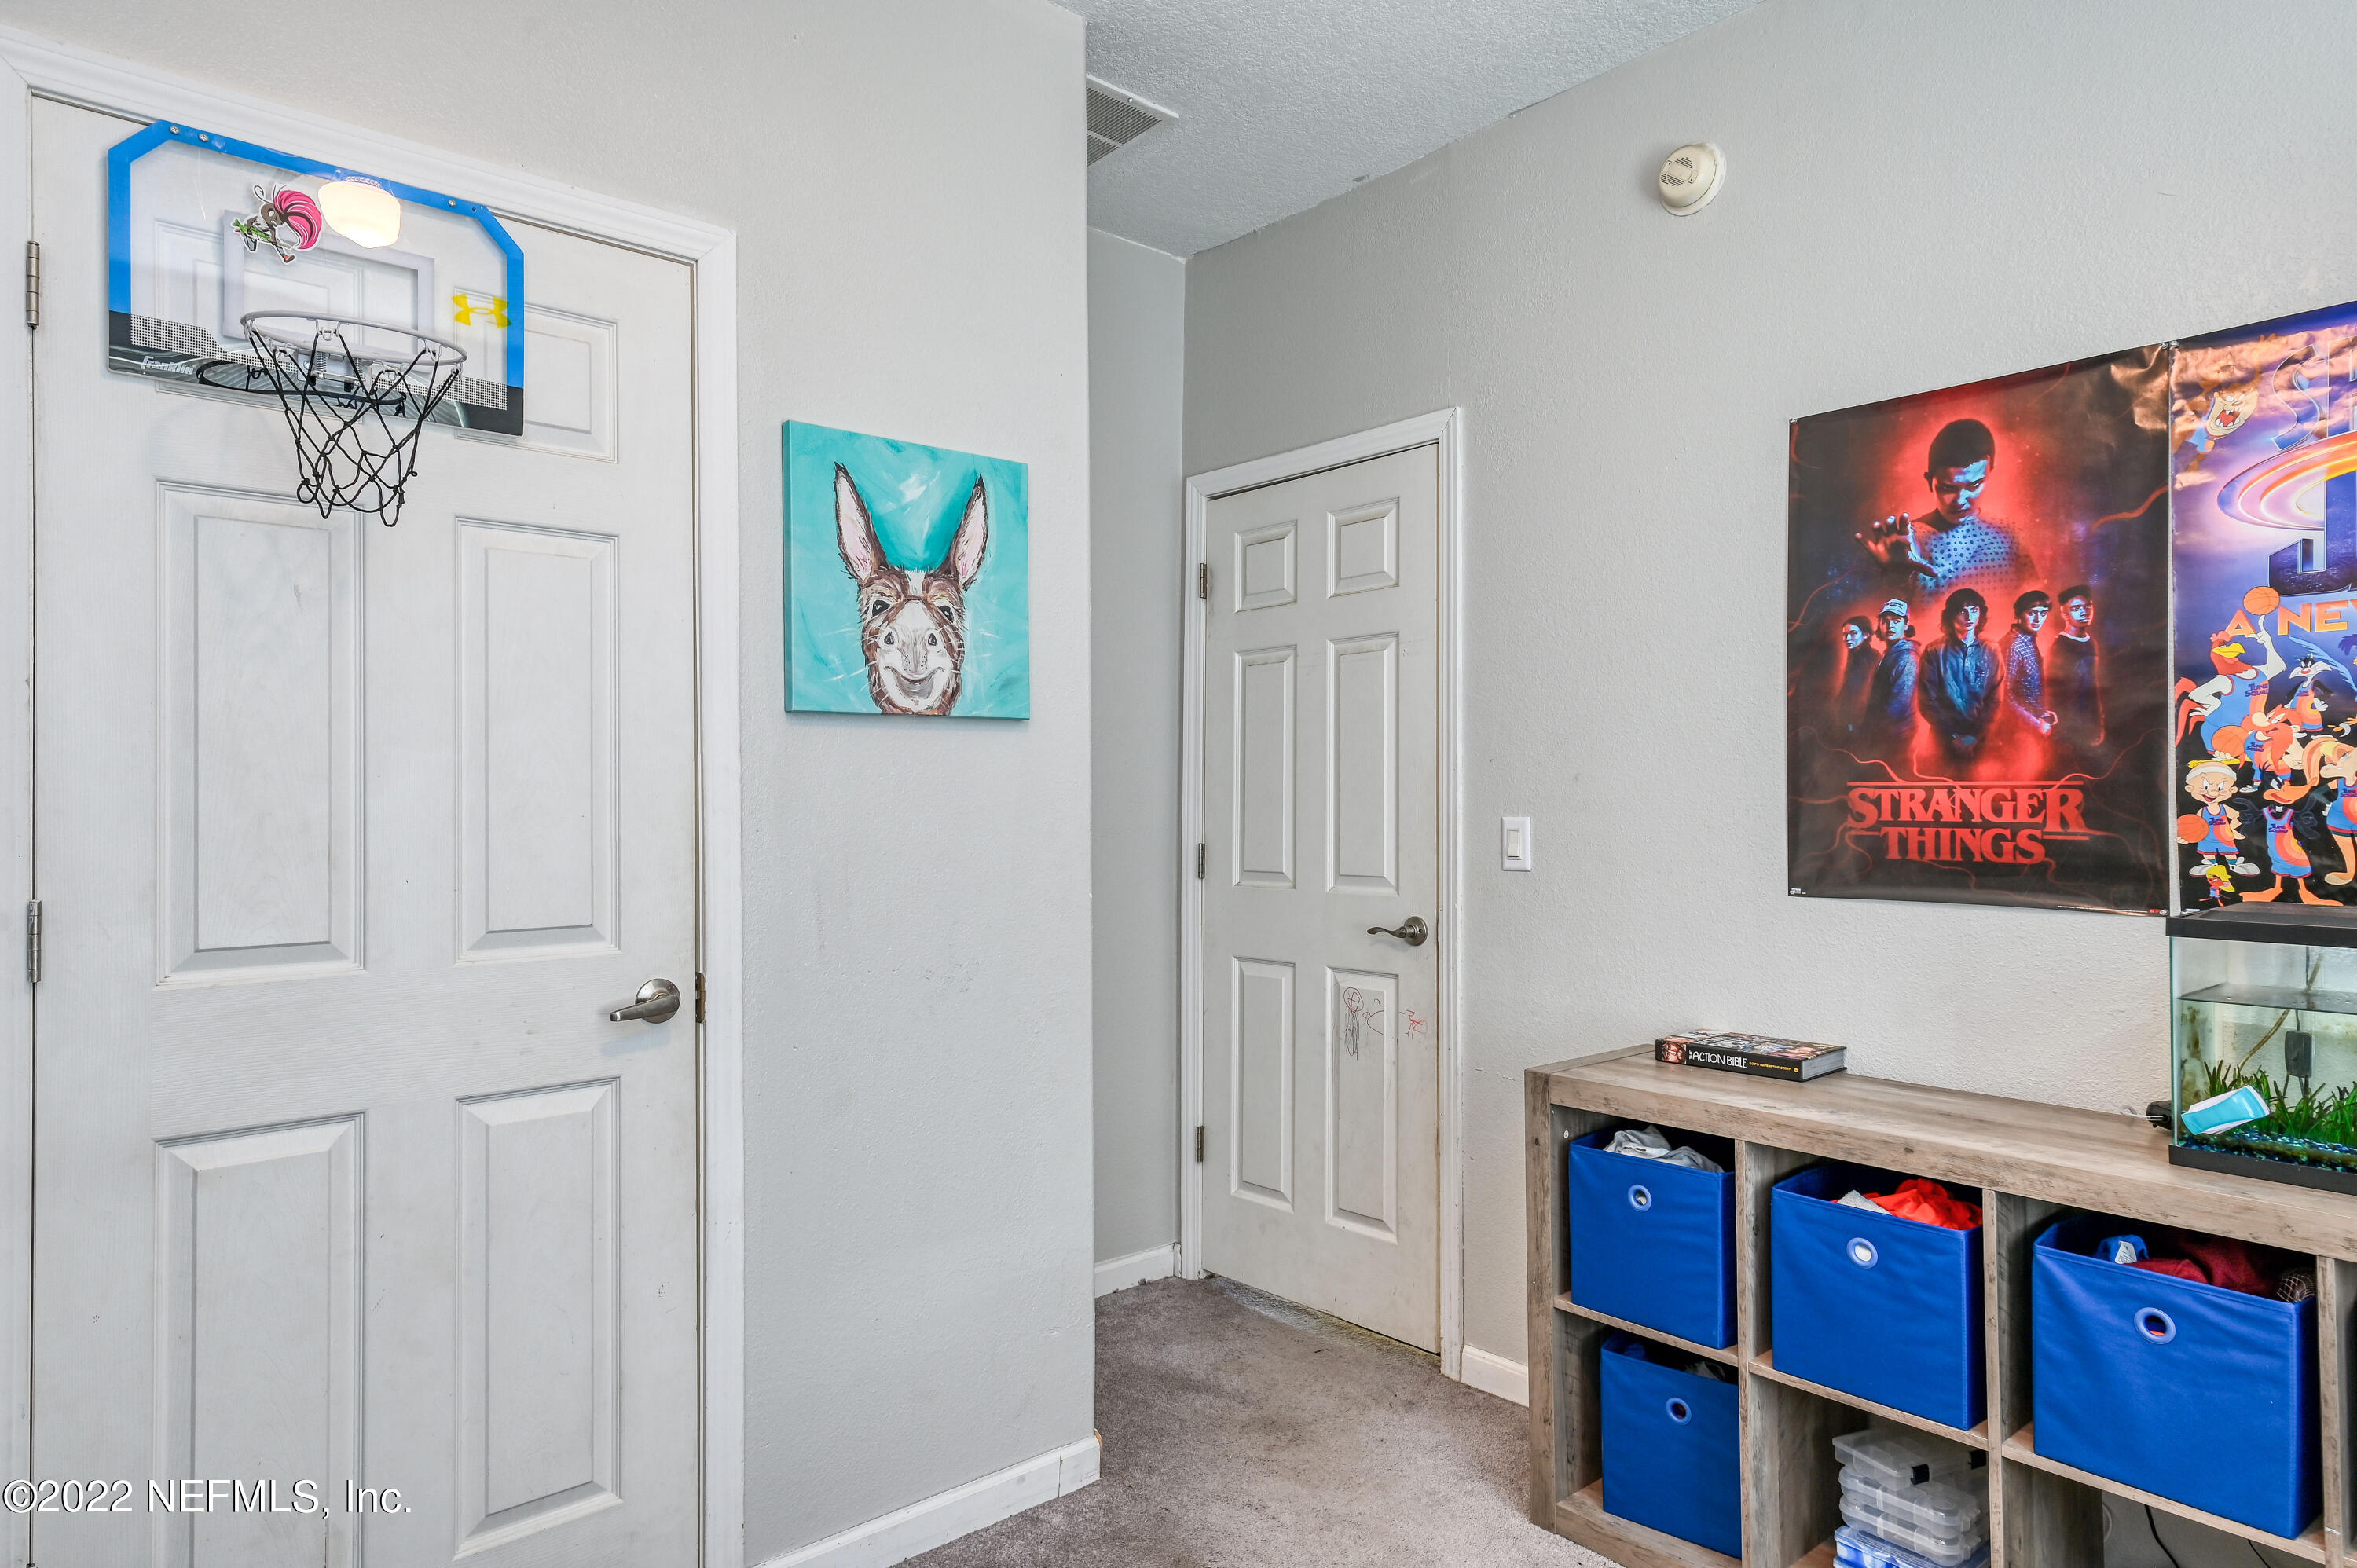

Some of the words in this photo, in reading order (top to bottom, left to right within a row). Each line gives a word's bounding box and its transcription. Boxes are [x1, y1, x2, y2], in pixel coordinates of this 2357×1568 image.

[2225, 609, 2256, 638] A
[2278, 599, 2357, 636] NE
[1847, 788, 2088, 833] STRANGER
[1880, 827, 2046, 864] THINGS
[1692, 1051, 1725, 1065] ACTION
[1726, 1055, 1748, 1068] BIBLE
